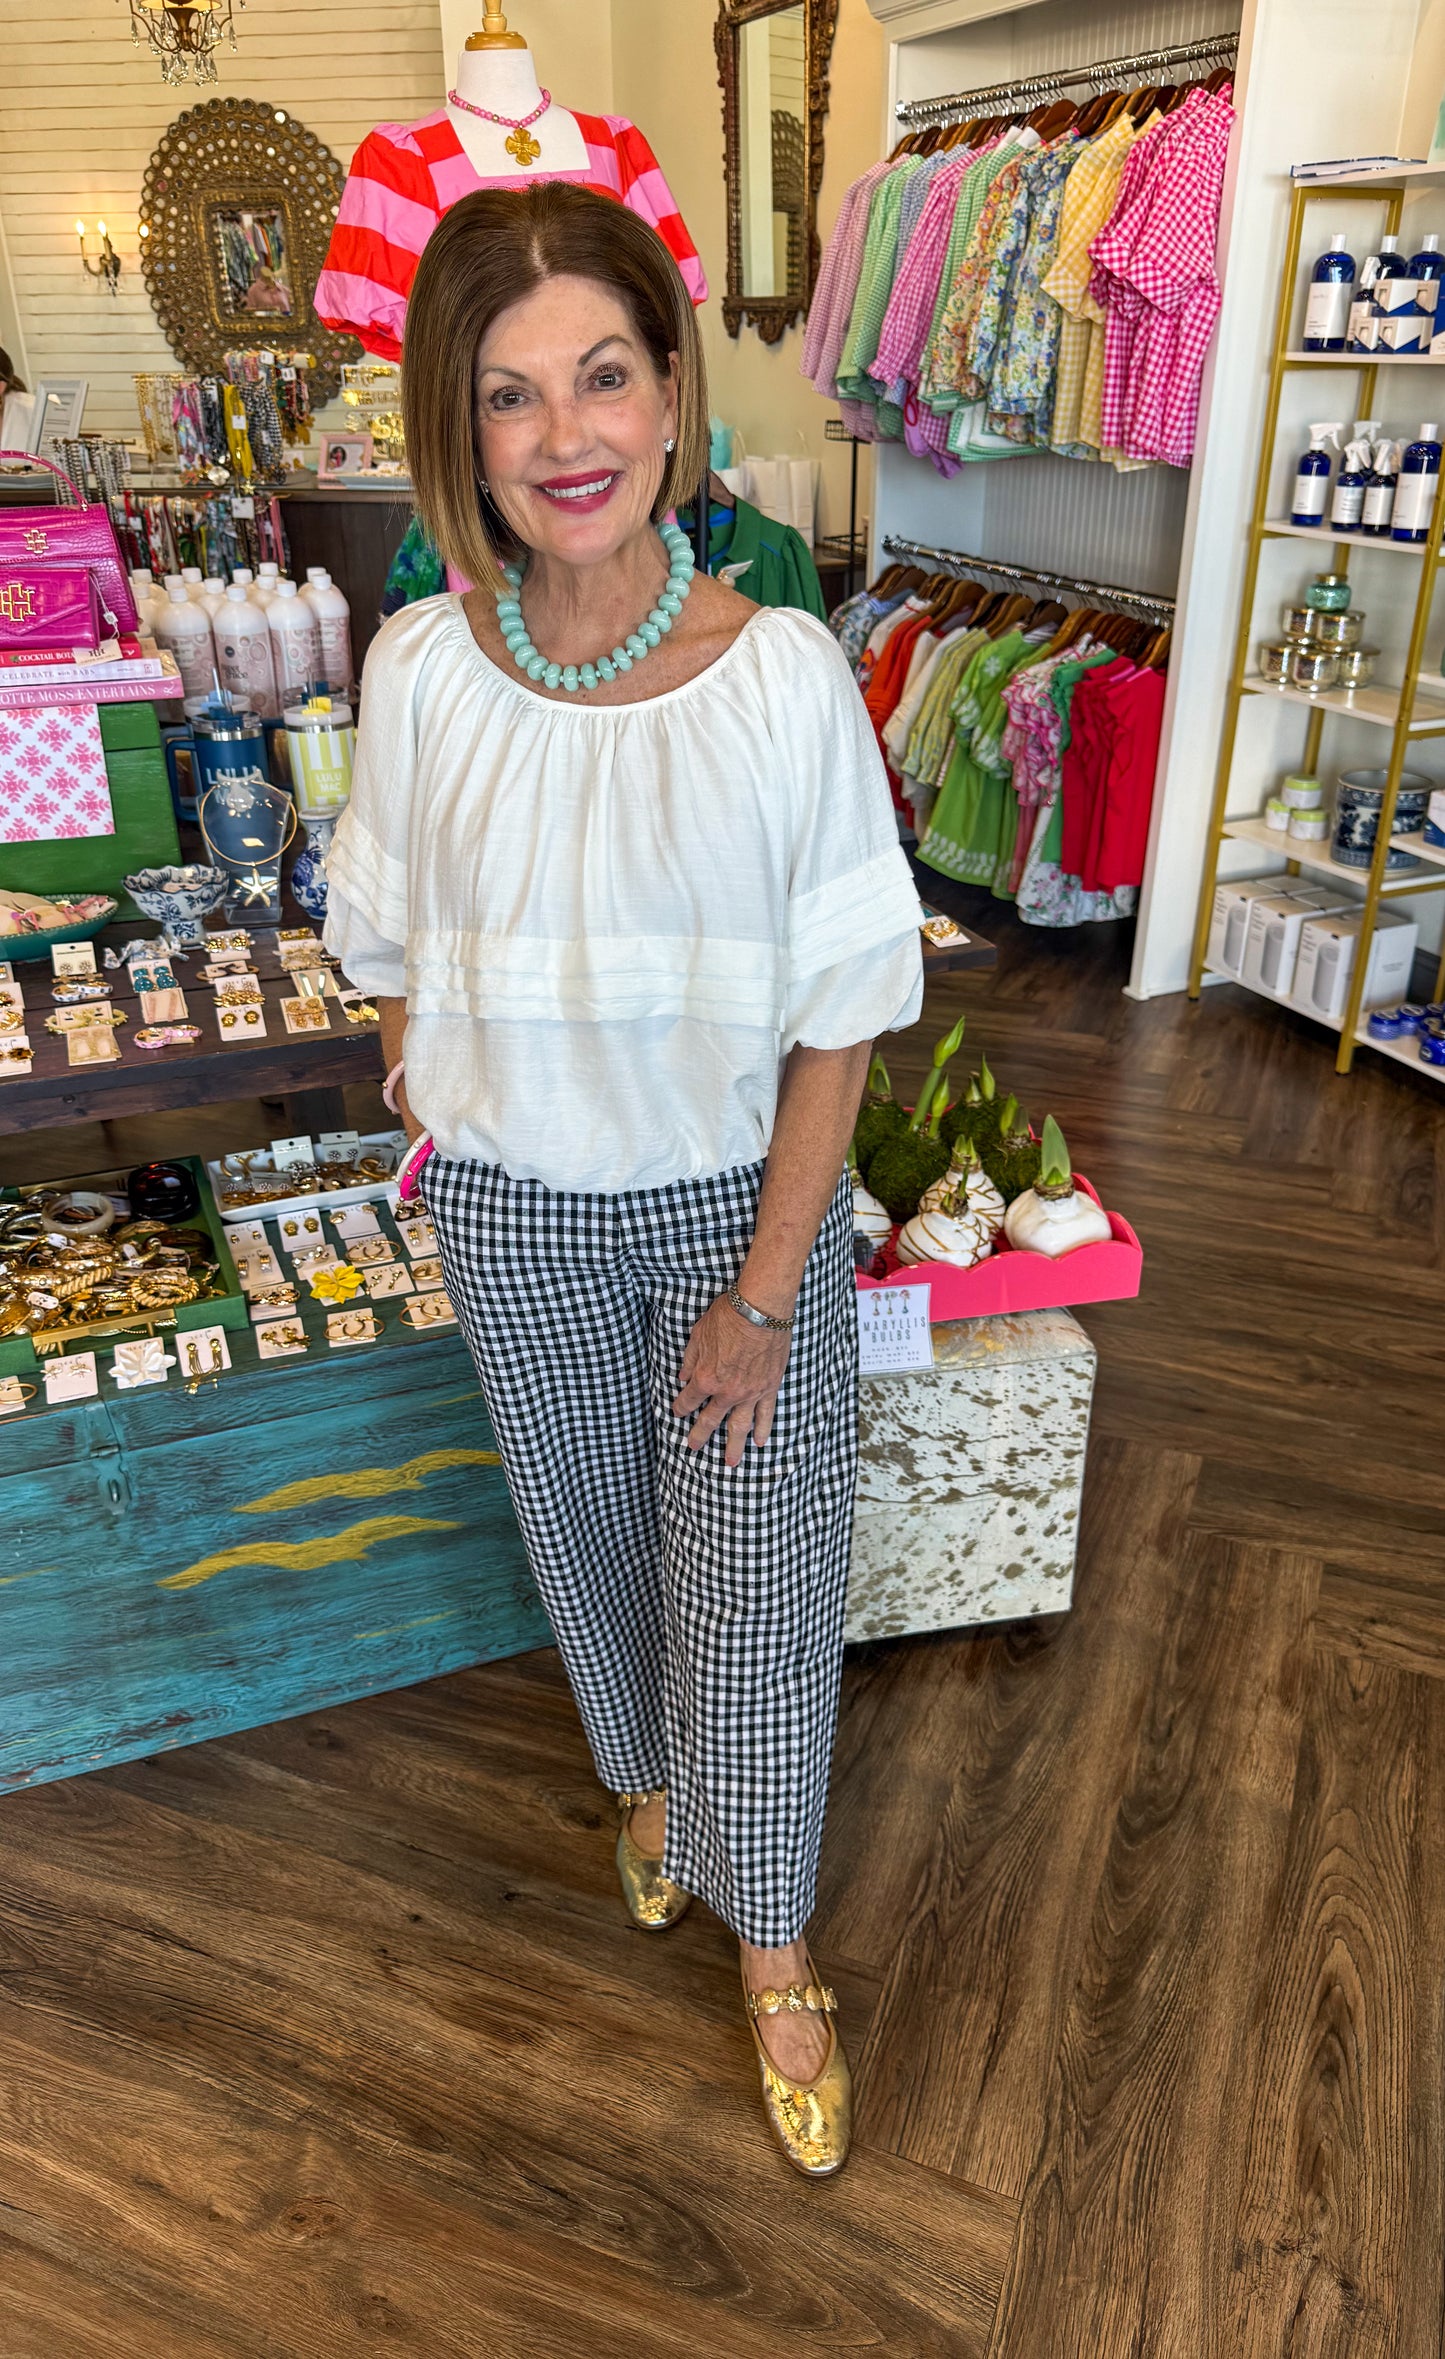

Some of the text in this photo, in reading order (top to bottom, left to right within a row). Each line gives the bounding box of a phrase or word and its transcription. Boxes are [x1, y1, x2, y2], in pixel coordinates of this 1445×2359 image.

[18, 652, 55, 663] COCKTAIL
[2, 671, 54, 681] CELEBRATE
[73, 668, 96, 677] BABS
[0, 691, 36, 705] OTTE
[38, 689, 75, 703] MOSS
[77, 684, 156, 700] ENTERTAINS
[315, 771, 342, 783] LULU
[863, 1316, 926, 1332] MARYLLIS
[871, 1329, 911, 1343] BULBS
